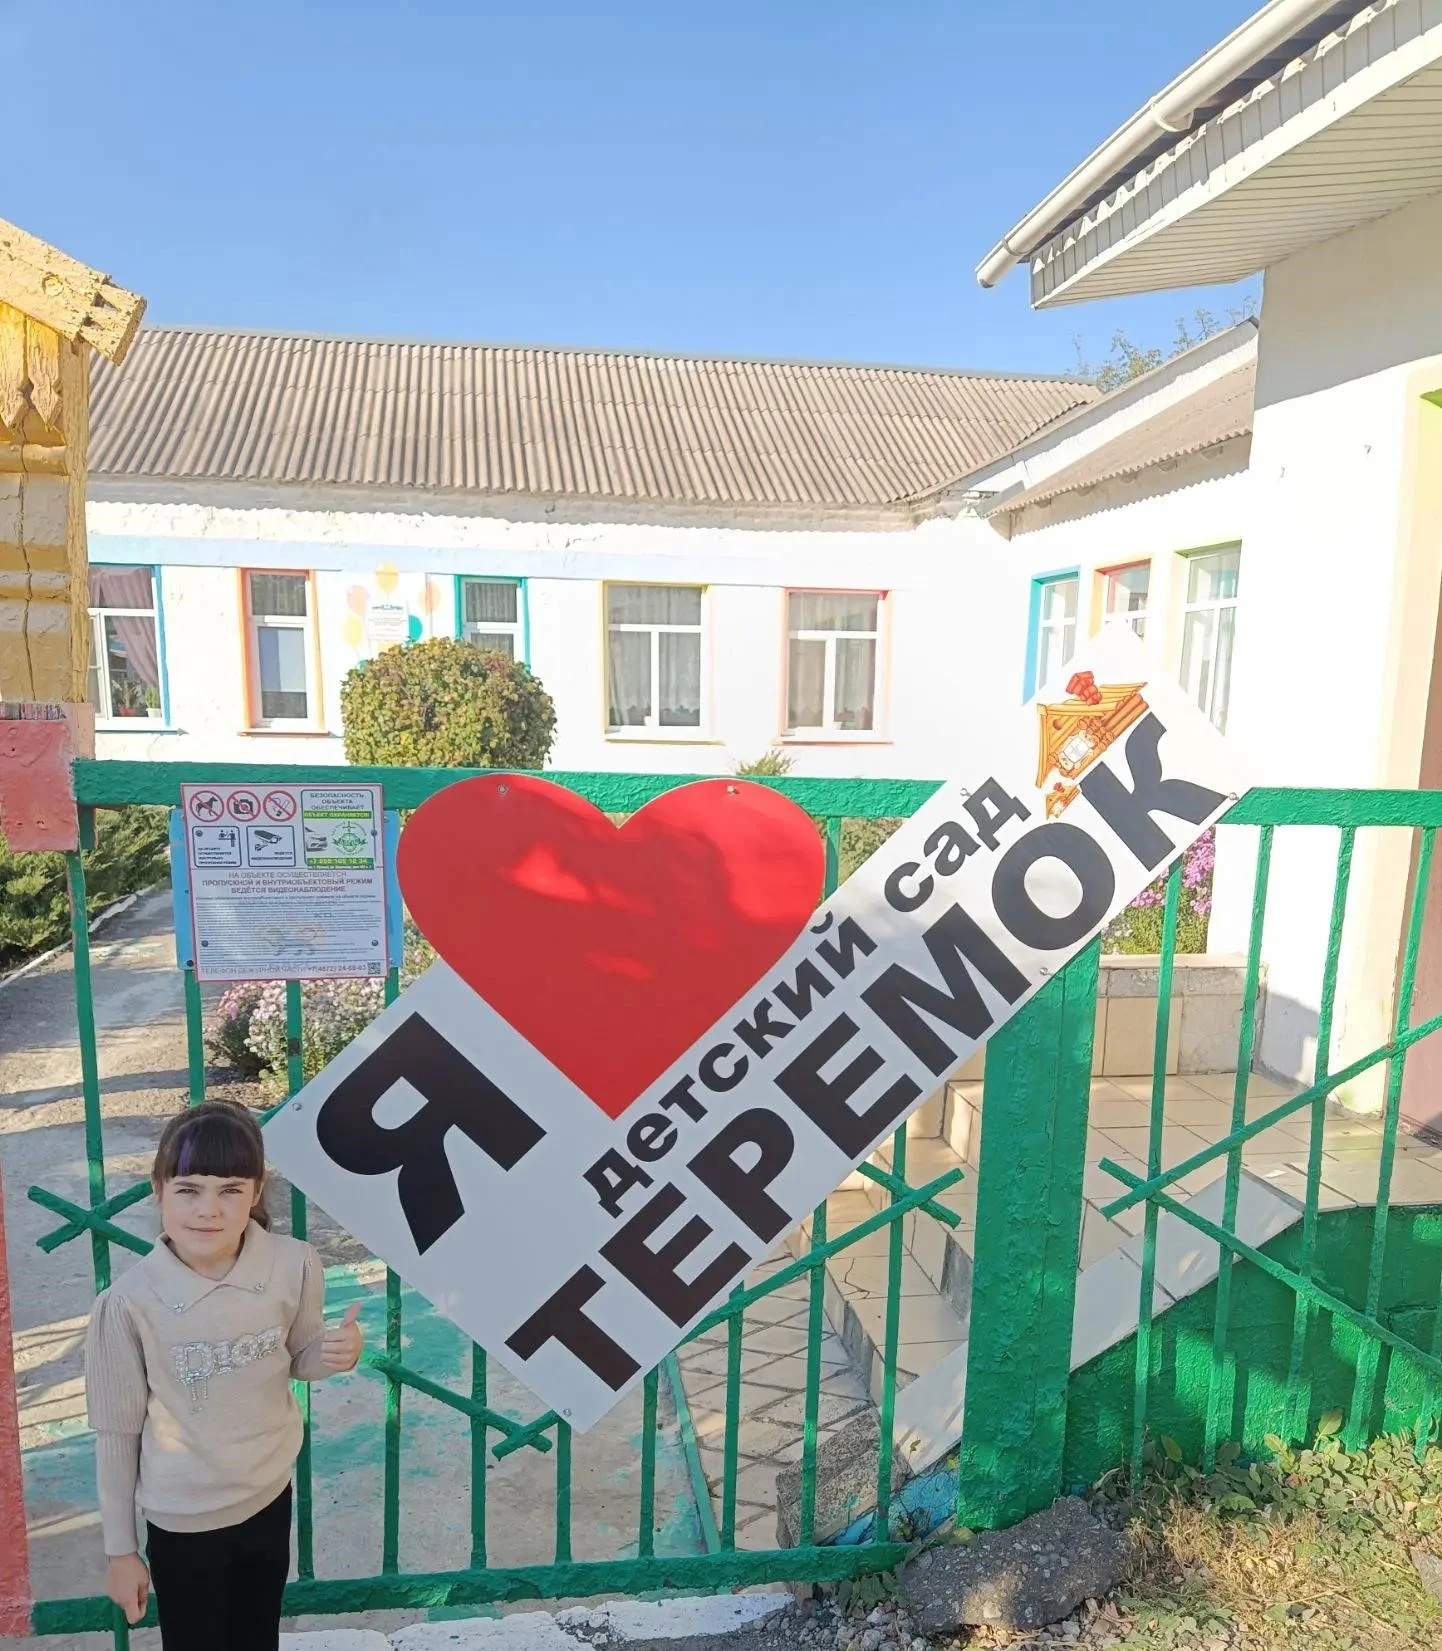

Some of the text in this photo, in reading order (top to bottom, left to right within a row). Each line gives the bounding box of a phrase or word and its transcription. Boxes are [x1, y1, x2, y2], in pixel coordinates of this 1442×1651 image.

[202, 878, 254, 886] ПРОПУСКНОЙ
[263, 878, 345, 886] ВНУТРИОБЪЕКТОВЫЙ
[268, 885, 346, 893] ВИДЕОНАБЛЮДЕНИЕ
[582, 776, 1030, 1218] детский сад
[316, 1010, 546, 1256] Я
[504, 713, 1228, 1392] ТЕРЕМОК
